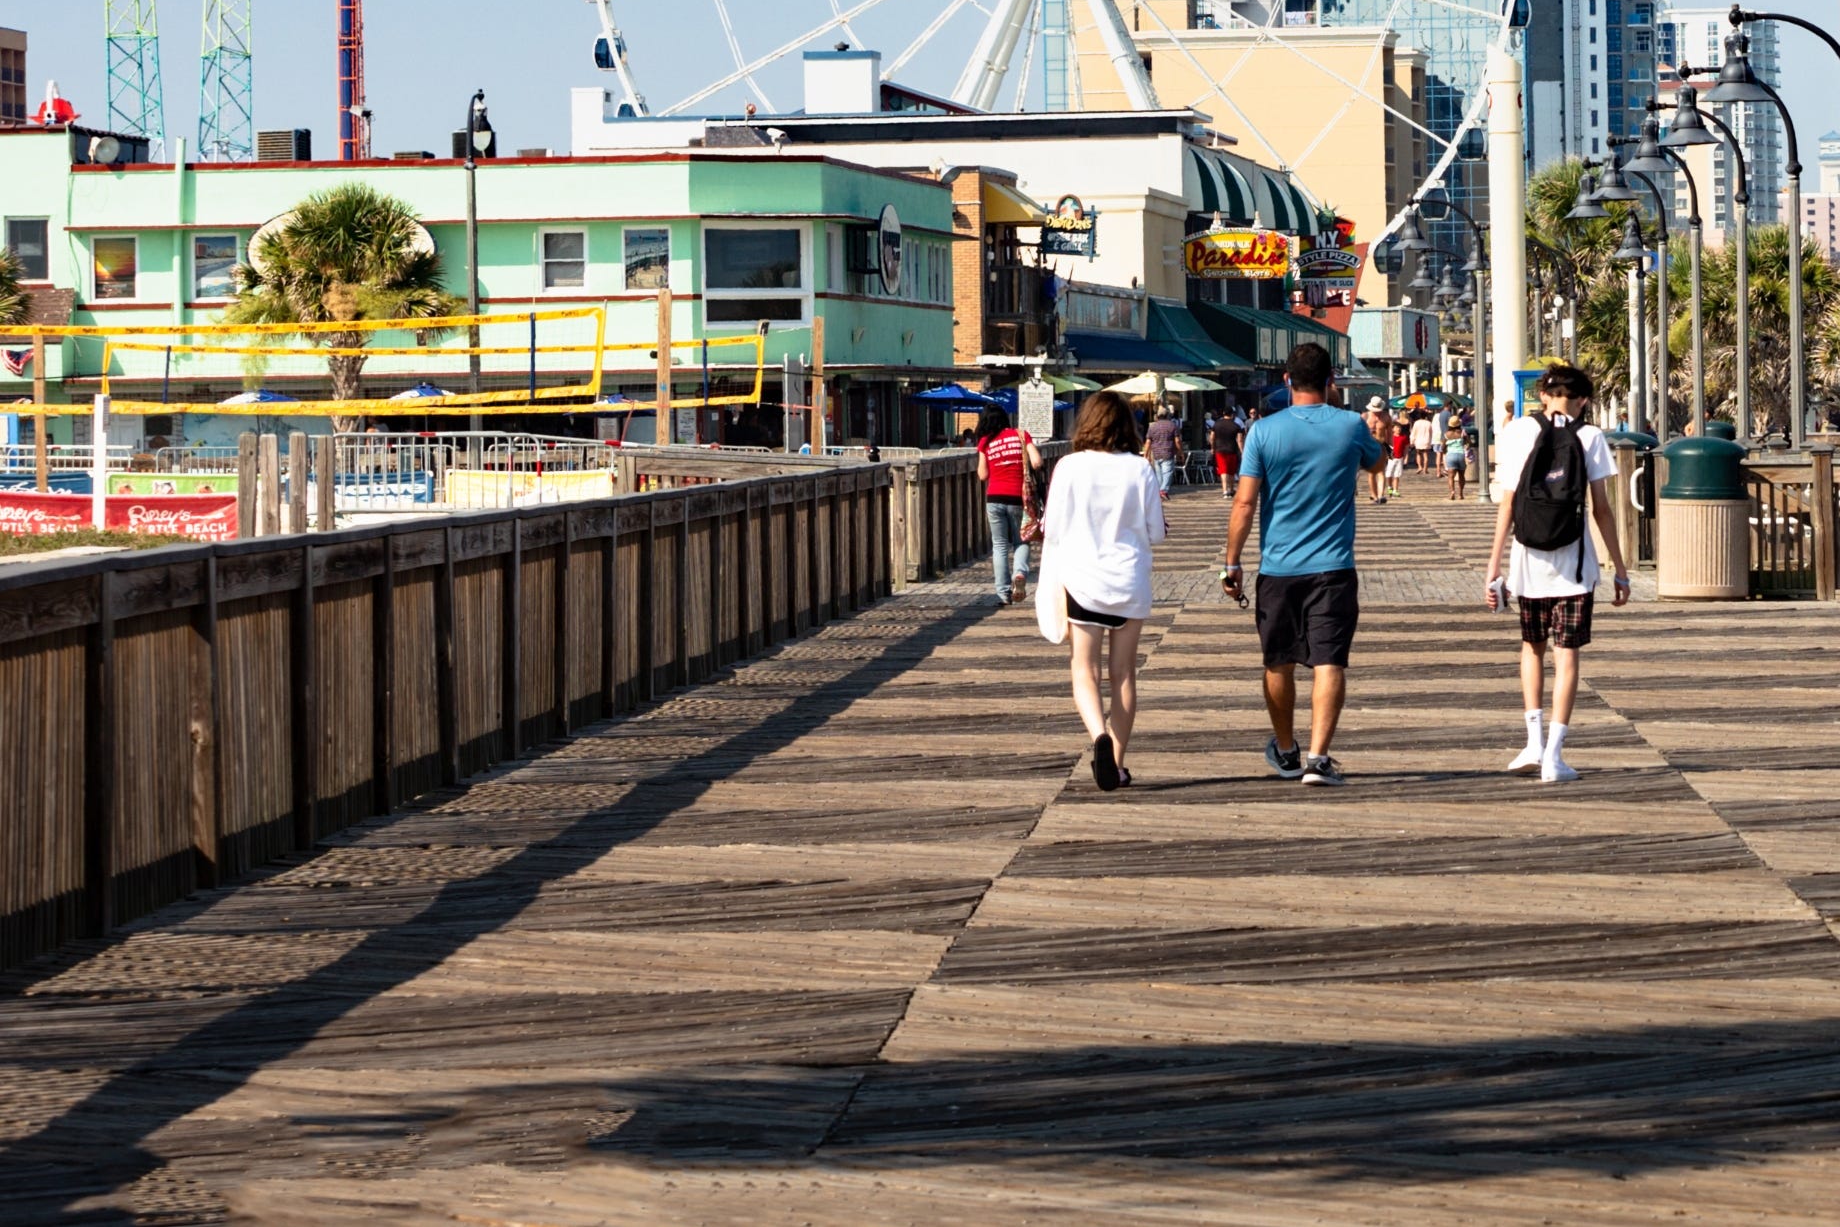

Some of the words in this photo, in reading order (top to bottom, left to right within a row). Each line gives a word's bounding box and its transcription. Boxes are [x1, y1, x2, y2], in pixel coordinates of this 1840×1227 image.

[1315, 230, 1340, 249] N.Y.
[1297, 251, 1327, 265] STYLE
[1328, 251, 1355, 265] PIZZA
[185, 523, 228, 533] BEACH
